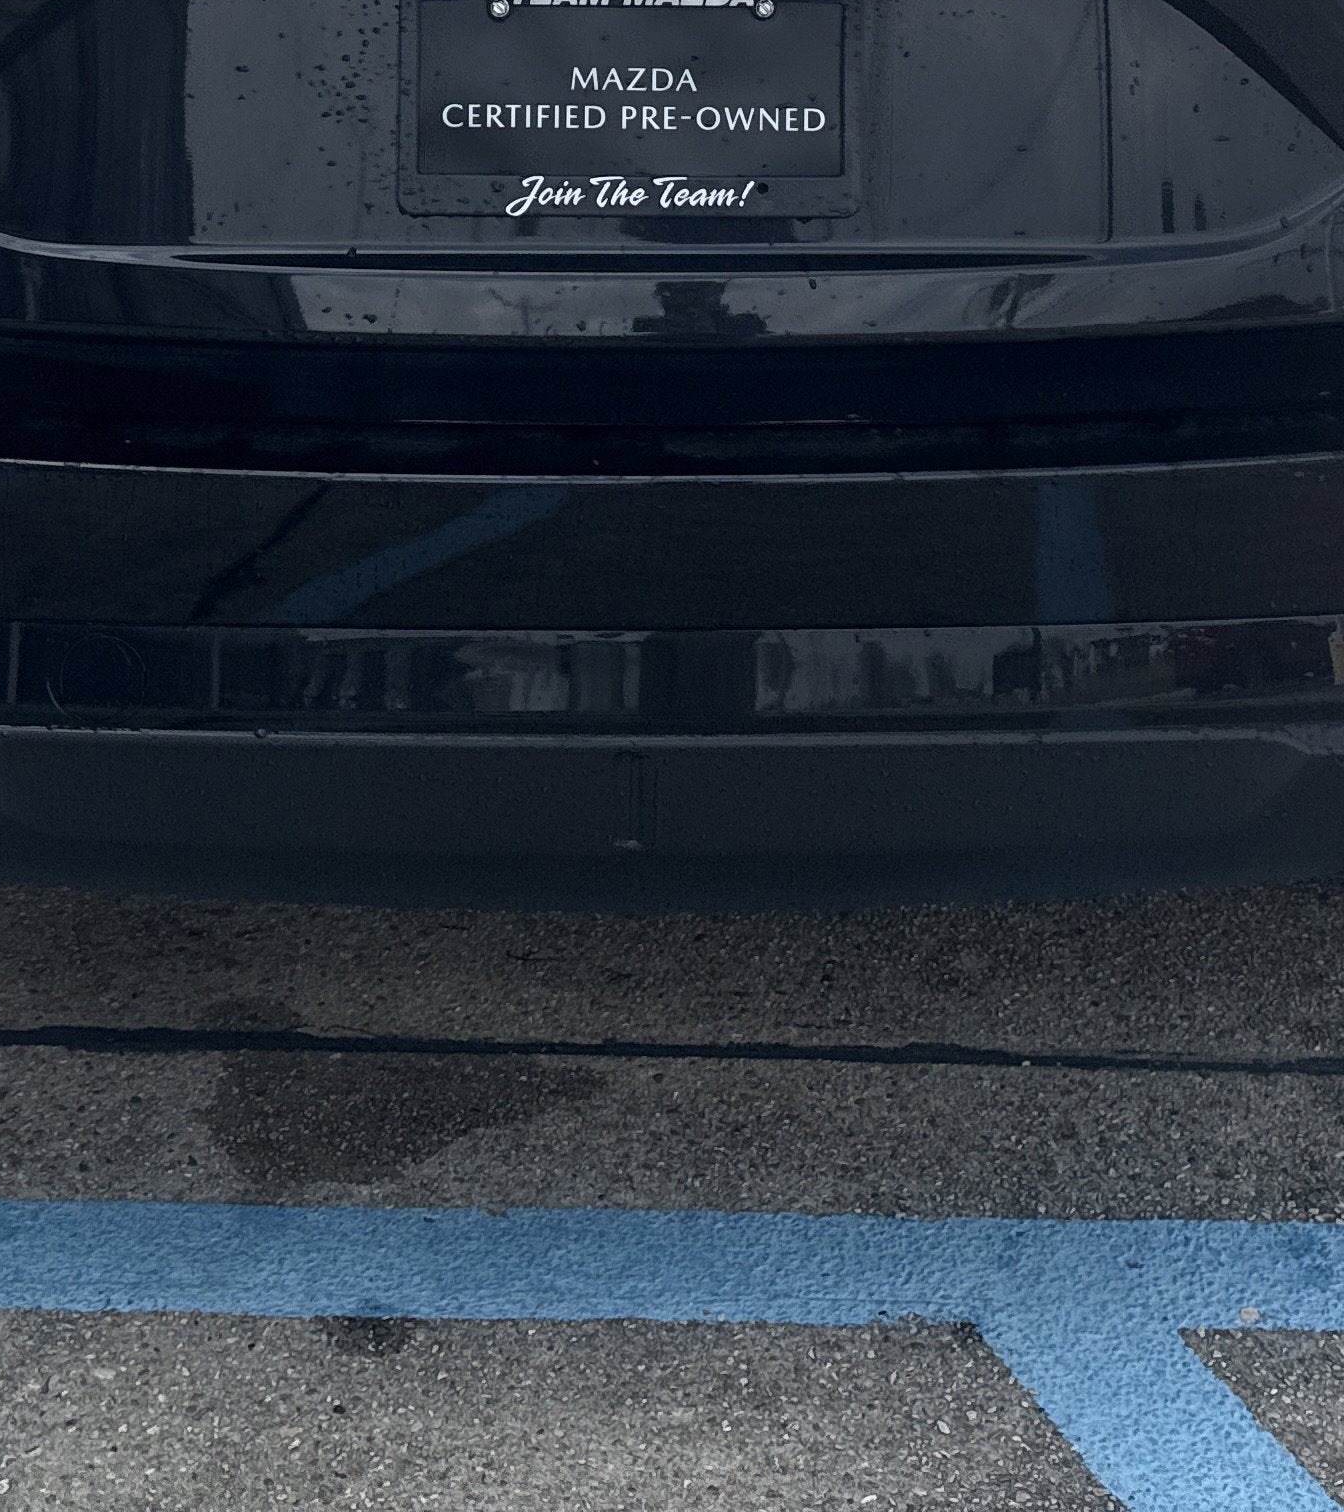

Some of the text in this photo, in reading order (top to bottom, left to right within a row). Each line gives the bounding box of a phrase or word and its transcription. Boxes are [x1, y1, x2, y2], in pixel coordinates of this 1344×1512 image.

[570, 66, 698, 92] MAZDA
[441, 103, 827, 132] CERTIFIED PRE-OWNED
[505, 175, 756, 217] Join The Team!
